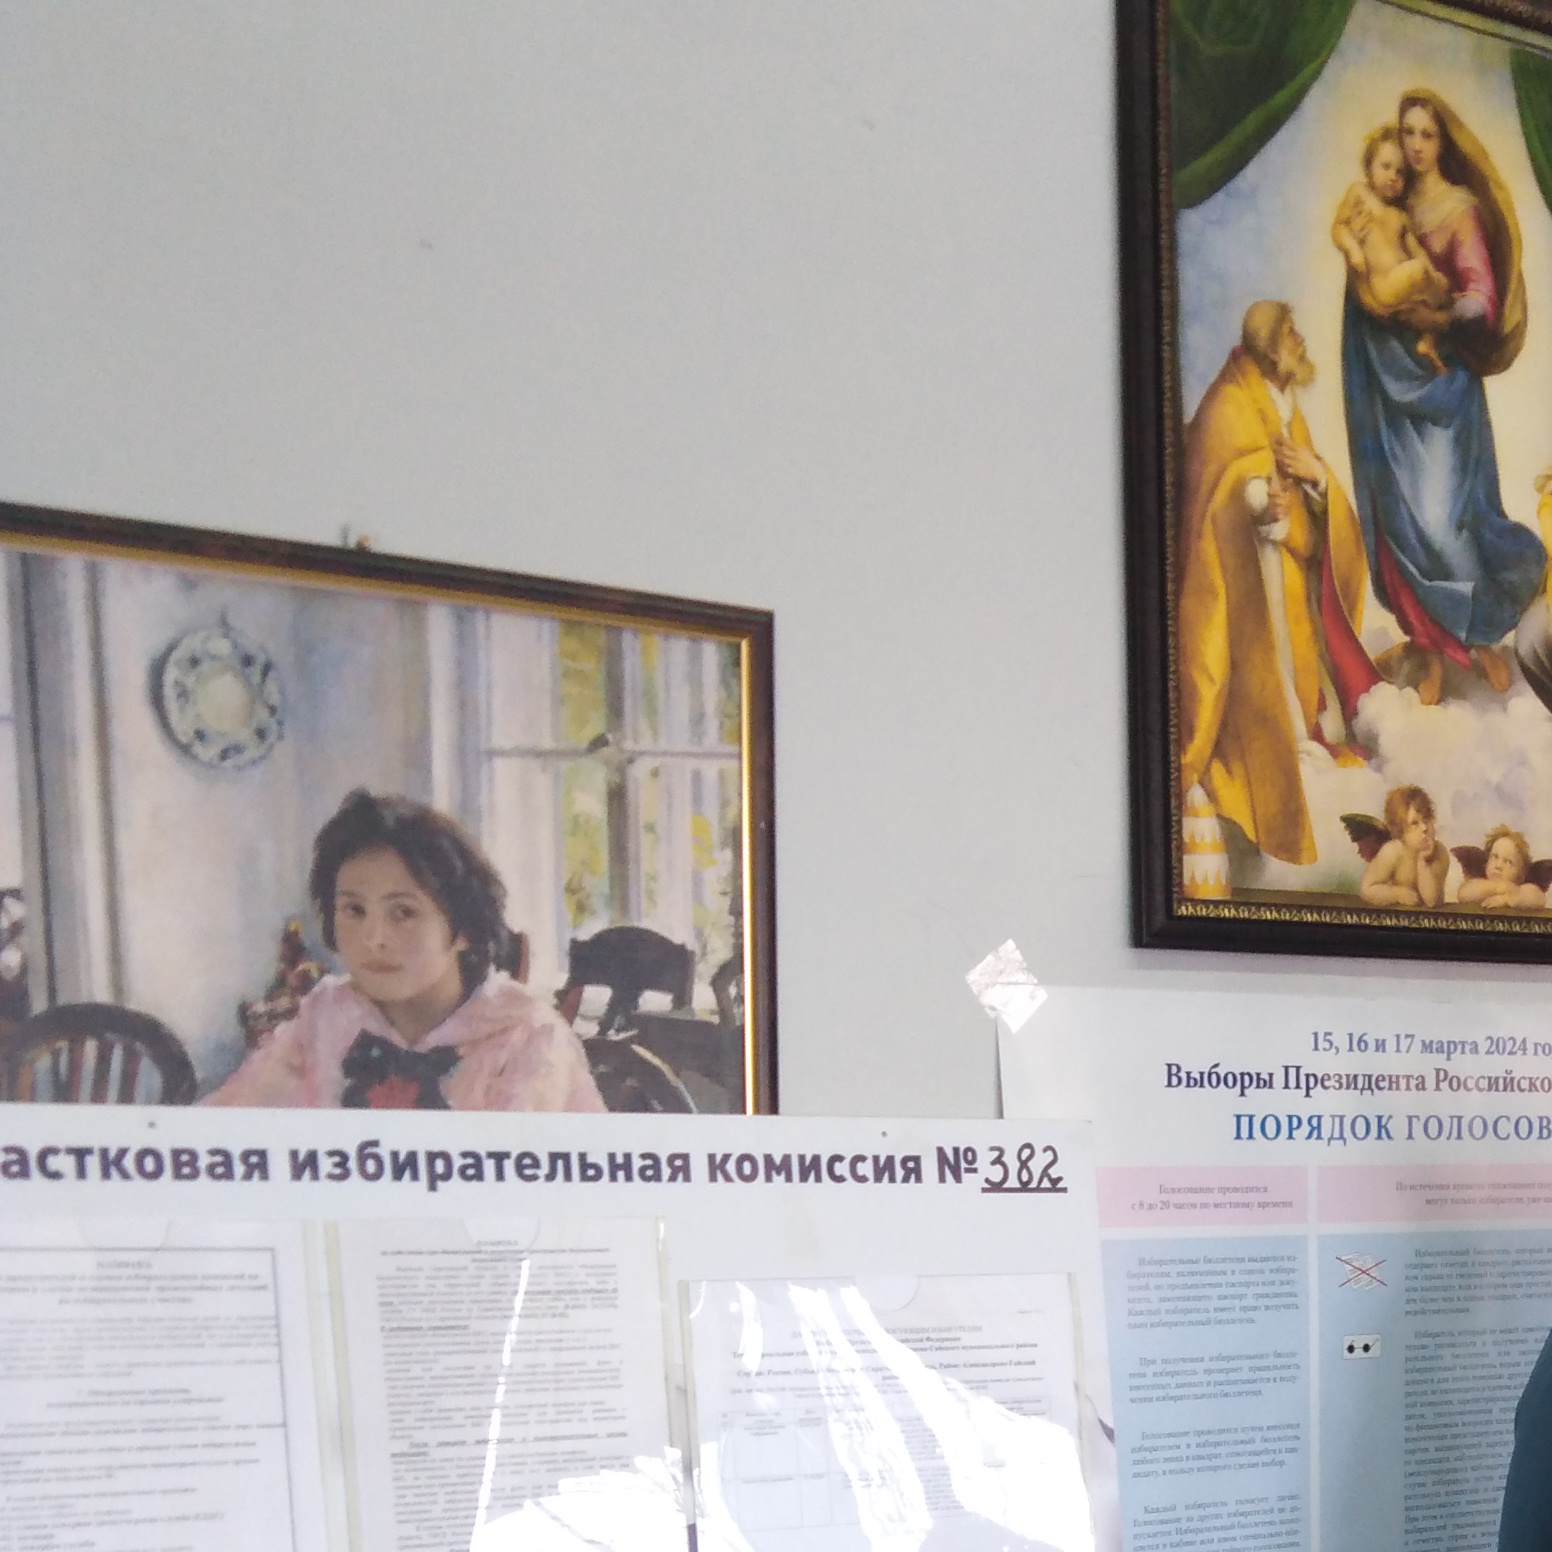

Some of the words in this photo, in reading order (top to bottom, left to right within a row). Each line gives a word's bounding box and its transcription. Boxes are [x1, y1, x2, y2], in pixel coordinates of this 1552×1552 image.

[1311, 1031, 1340, 1056] 15,
[1346, 1032, 1369, 1053] 16
[1374, 1038, 1387, 1053] и
[1393, 1033, 1416, 1054] 17
[1420, 1038, 1479, 1061] марта
[1484, 1036, 1528, 1056] 2024
[1164, 1062, 1274, 1097] Выборы
[1281, 1065, 1427, 1098] Президента
[1233, 1113, 1394, 1147] ПОРЯДОК
[0, 1144, 269, 1181] астковая
[288, 1139, 692, 1193] избирательная
[707, 1152, 923, 1184] комиссия
